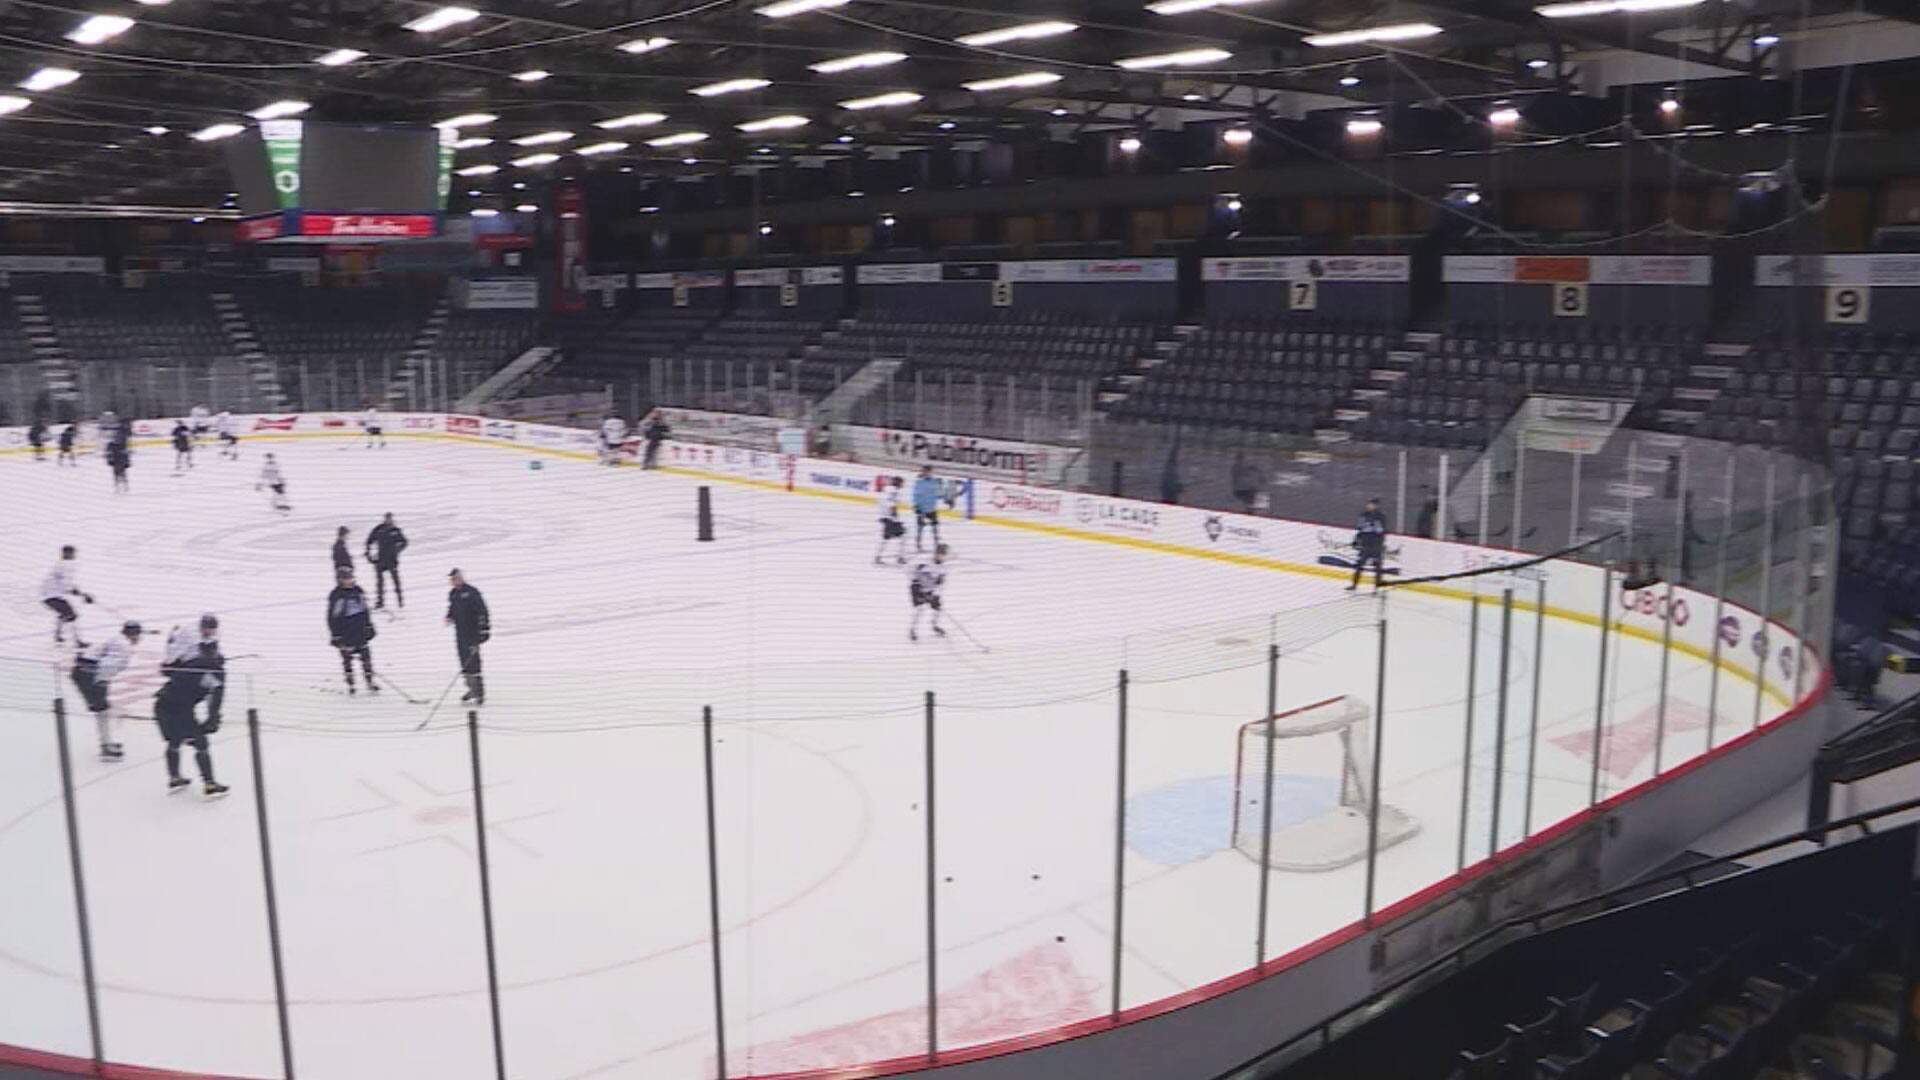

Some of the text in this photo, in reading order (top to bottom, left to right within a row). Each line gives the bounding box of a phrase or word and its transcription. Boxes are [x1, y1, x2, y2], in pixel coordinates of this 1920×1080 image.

[1295, 283, 1310, 305] 7
[1561, 287, 1581, 312] 8
[1836, 290, 1861, 318] 9
